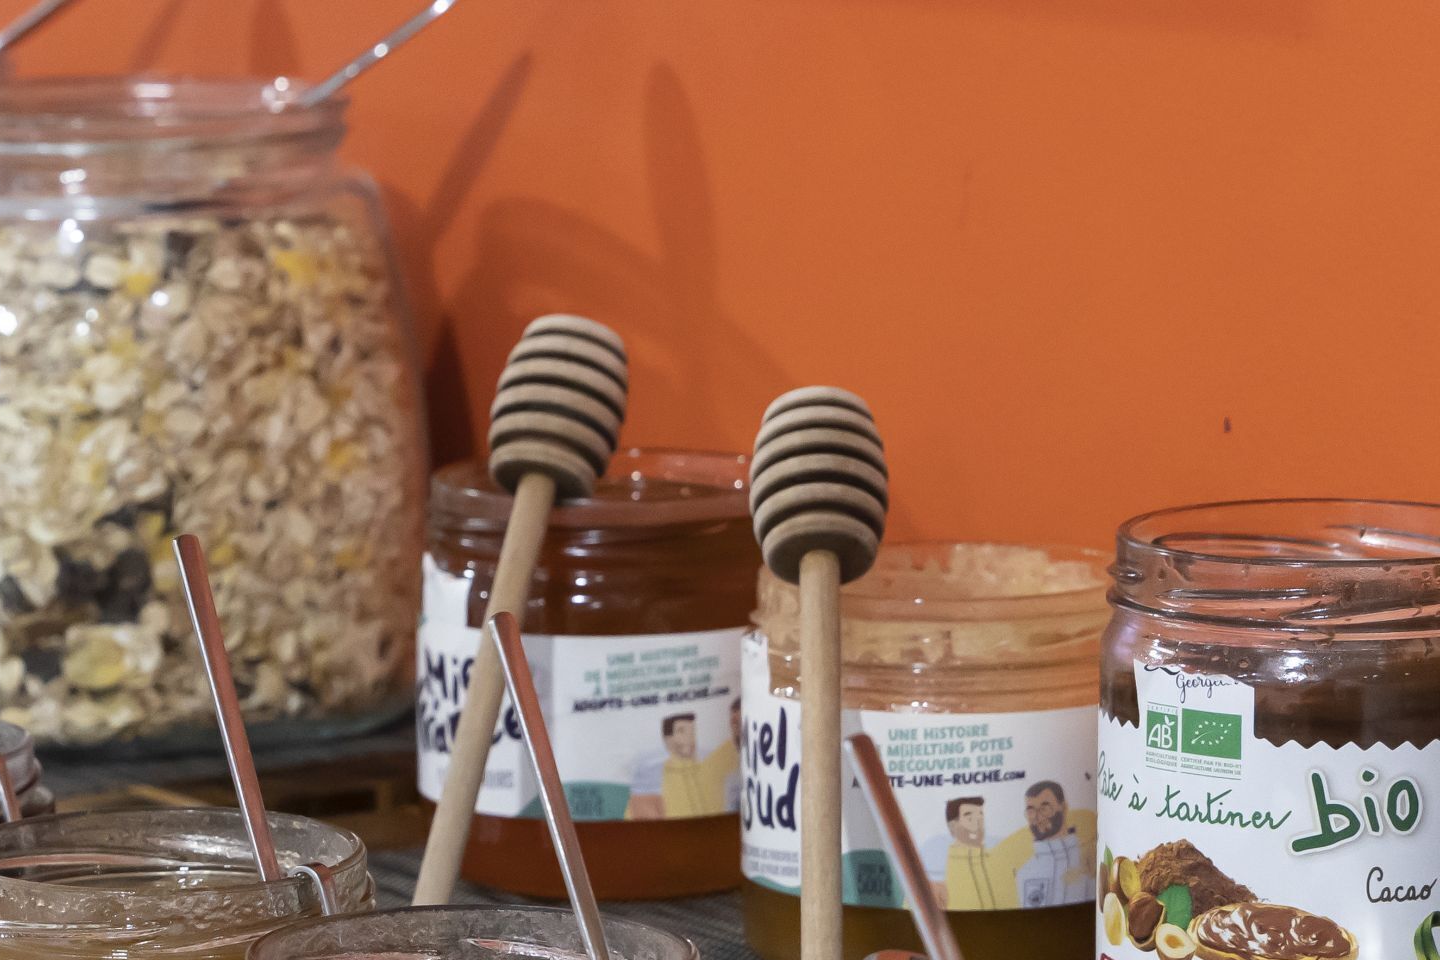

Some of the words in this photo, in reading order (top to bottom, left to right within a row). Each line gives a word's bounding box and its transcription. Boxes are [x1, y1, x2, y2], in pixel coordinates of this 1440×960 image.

[888, 728, 917, 741] UNE
[970, 736, 1014, 753] POTES
[1147, 723, 1173, 749] AB
[976, 754, 1004, 767] SUR
[1156, 784, 1292, 830] tartiner
[1291, 769, 1420, 854] bio
[1366, 866, 1438, 904] Cacao
